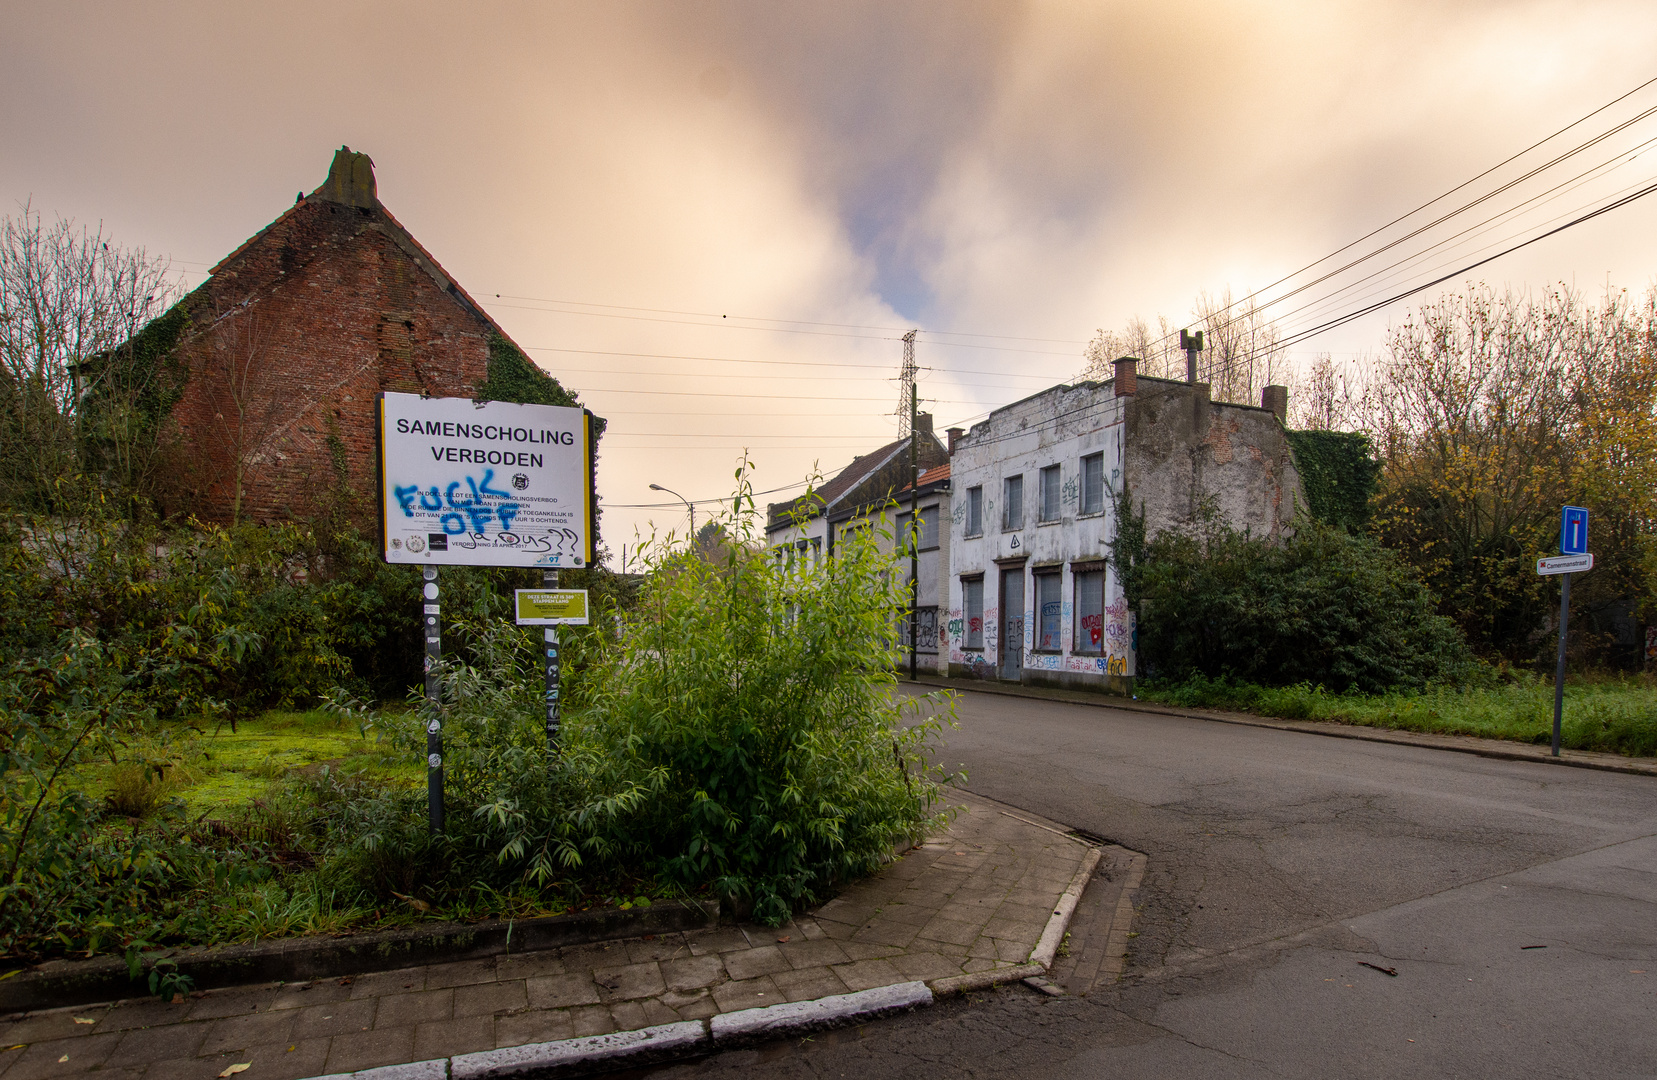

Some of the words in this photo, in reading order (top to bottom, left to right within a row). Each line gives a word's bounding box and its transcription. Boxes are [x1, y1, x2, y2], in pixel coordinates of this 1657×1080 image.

[396, 418, 574, 446] SAMENSCHOLING
[432, 446, 543, 468] VERBODEN
[393, 468, 509, 517] FUCK
[479, 494, 558, 503] SAMENSCHOLINGSVERBOD
[440, 503, 519, 535] OFF
[1547, 560, 1587, 569] Camermanstraat
